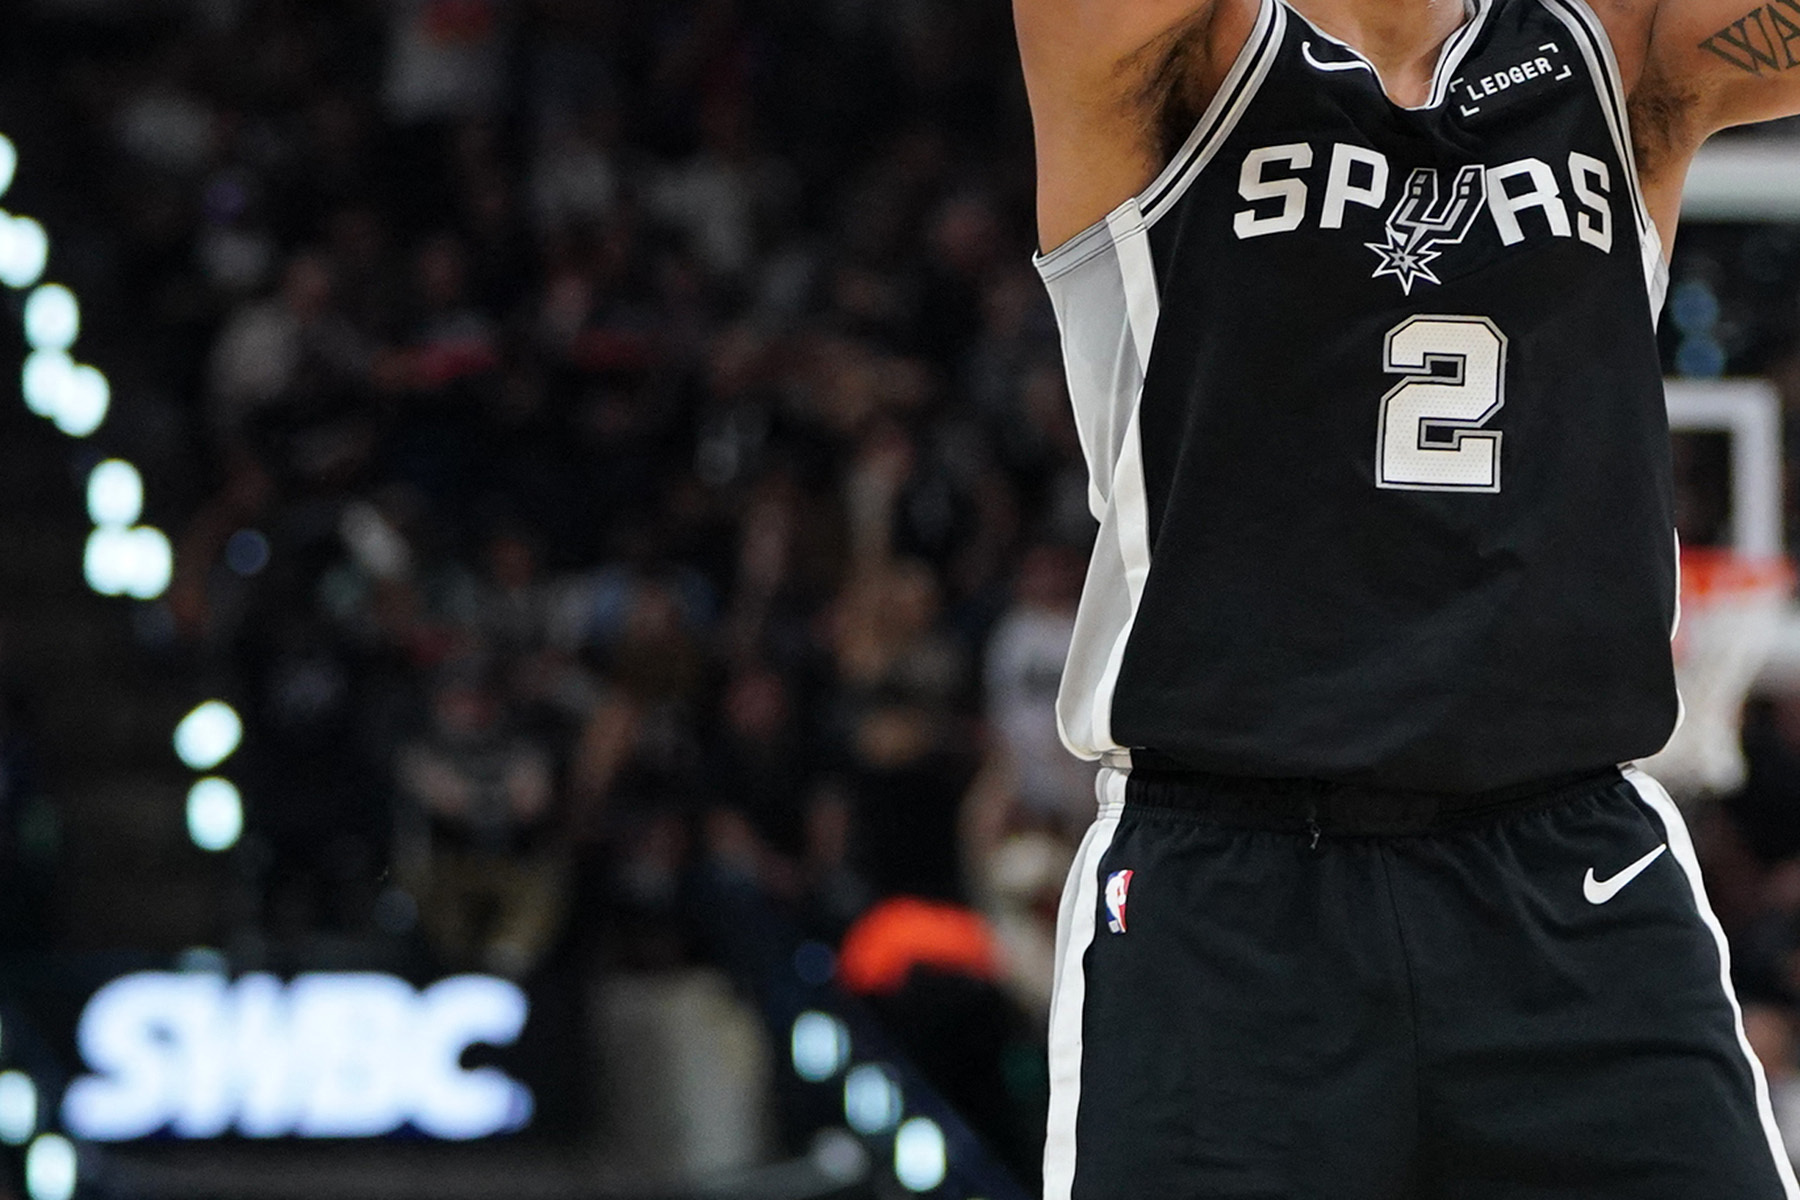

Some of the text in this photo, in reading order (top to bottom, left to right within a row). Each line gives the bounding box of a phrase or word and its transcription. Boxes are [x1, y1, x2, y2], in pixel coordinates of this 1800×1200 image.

[1466, 56, 1553, 101] LEDGER
[1232, 141, 1614, 296] SPURS
[1375, 313, 1509, 494] 2
[63, 971, 535, 1139] SWBC
